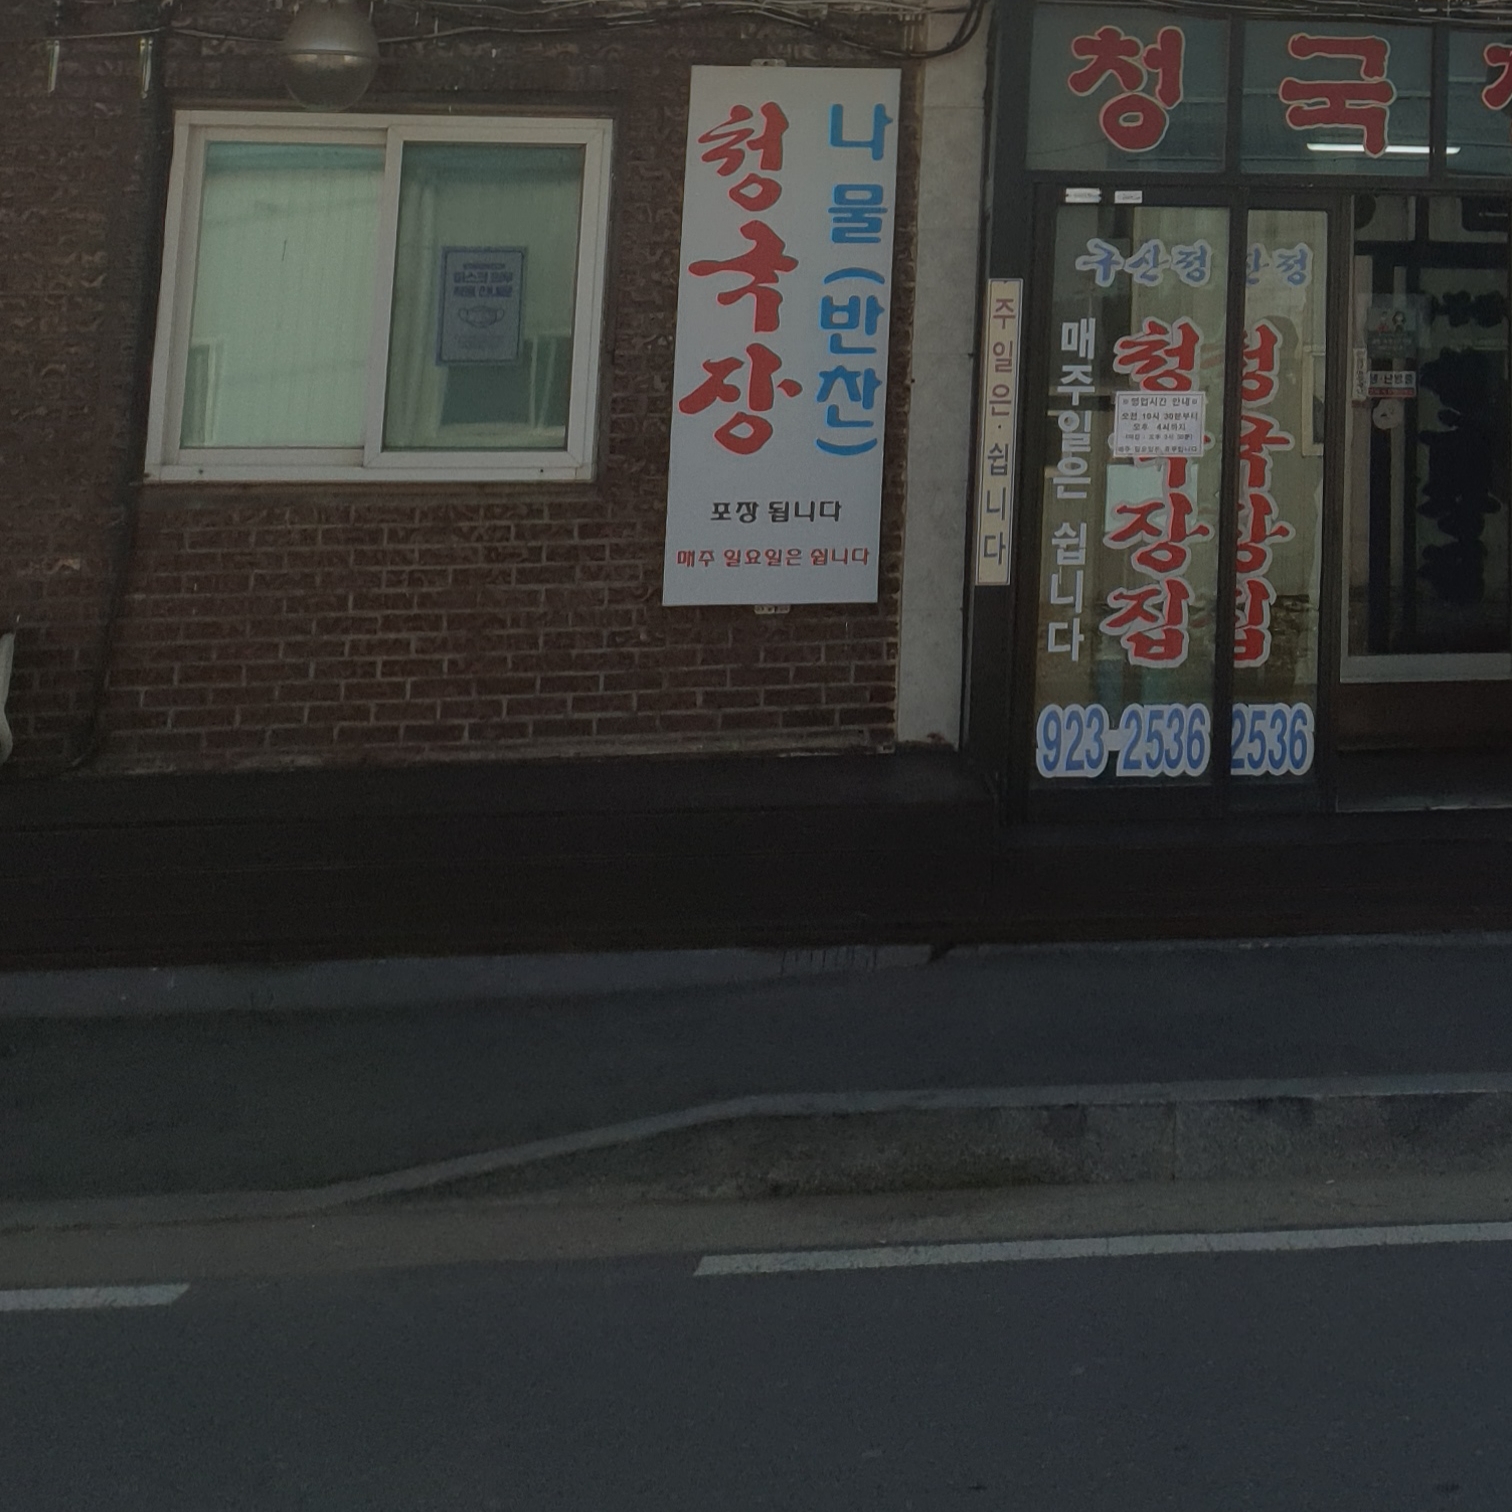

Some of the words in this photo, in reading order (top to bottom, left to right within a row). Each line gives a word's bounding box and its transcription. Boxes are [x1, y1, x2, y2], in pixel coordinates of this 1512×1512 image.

[678, 100, 803, 456] 청국장
[1077, 239, 1210, 286] 구산정
[1052, 317, 1097, 499] 매주일은
[710, 501, 759, 524] 포장
[768, 500, 842, 523] 됩니다
[676, 548, 715, 568] 매주
[723, 548, 802, 568] 일요일은
[810, 547, 870, 566] 쉽니다
[1046, 522, 1088, 662] 쉽니다
[1040, 705, 1209, 774] 923-2536
